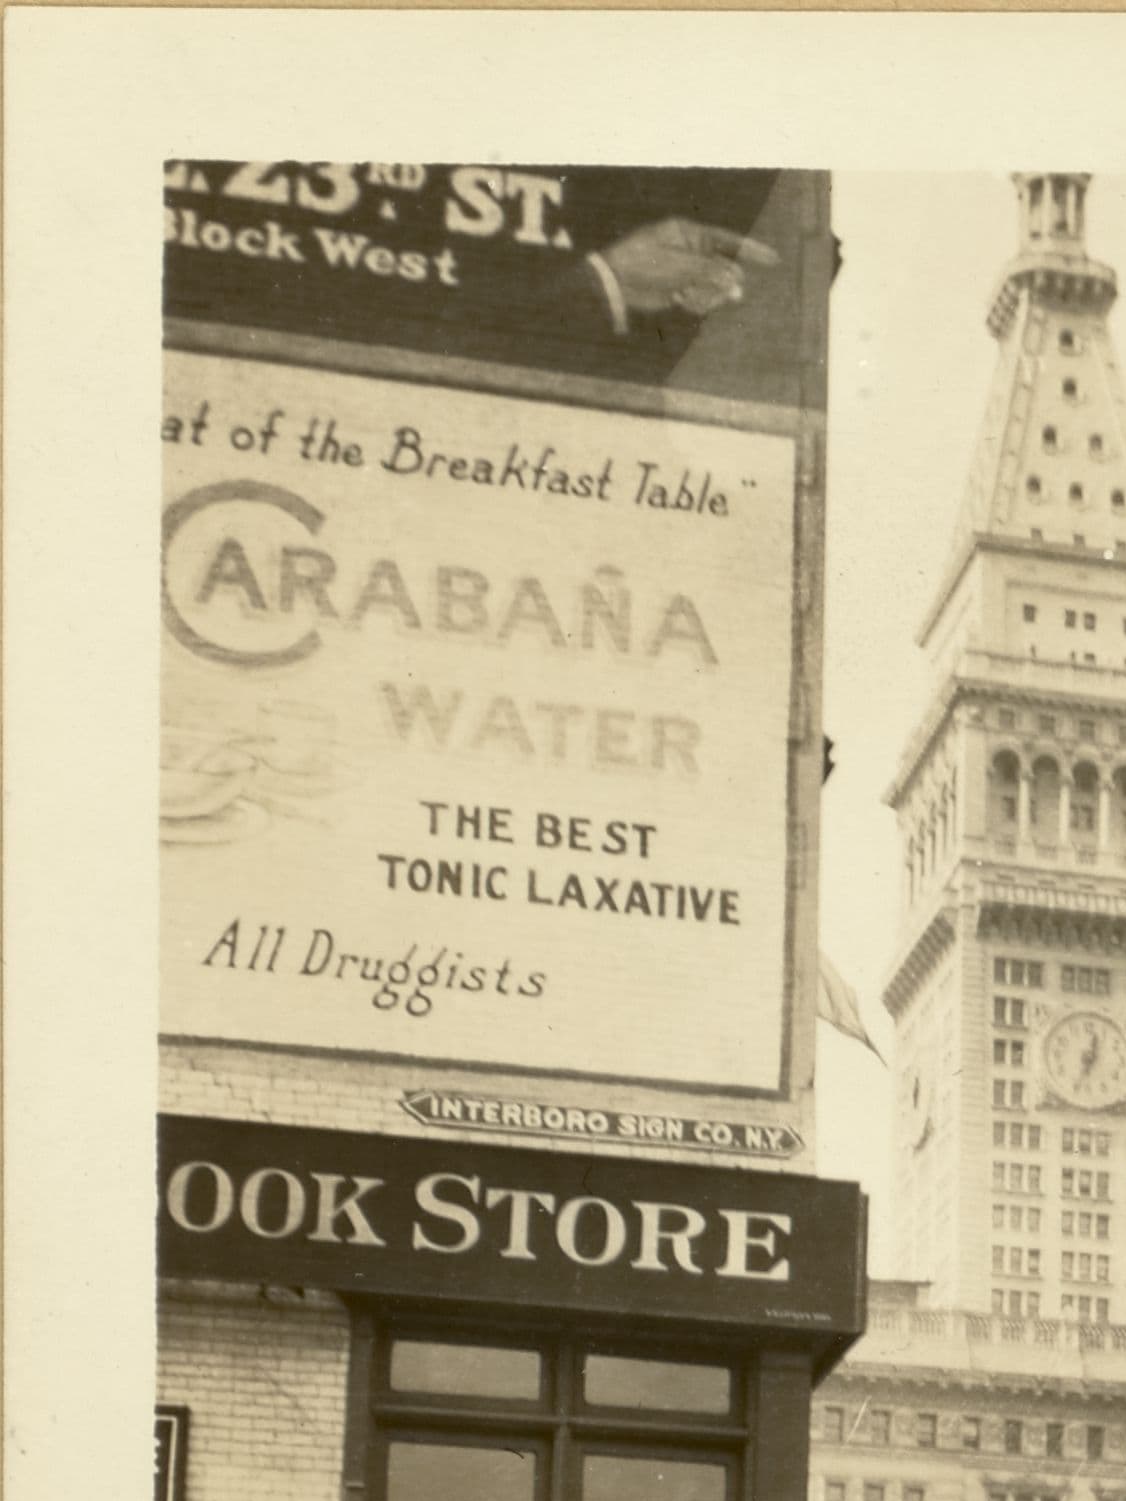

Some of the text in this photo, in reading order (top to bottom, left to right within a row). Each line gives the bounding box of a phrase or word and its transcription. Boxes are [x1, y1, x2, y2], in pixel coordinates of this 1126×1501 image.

[445, 165, 573, 250] ST.
[312, 225, 459, 286] West
[230, 410, 285, 454] of
[300, 417, 364, 467] the
[380, 425, 615, 502] Breakfast
[161, 479, 720, 669] CARABAÑA
[380, 681, 702, 776] WATER
[420, 801, 657, 859] THE BEST
[378, 855, 742, 926] TONIC LAXATIVE
[202, 918, 546, 1018] All Druggists
[430, 1097, 609, 1133] INTERBORO
[618, 1112, 683, 1140] SIGN
[166, 1162, 794, 1283] OOK STORE
